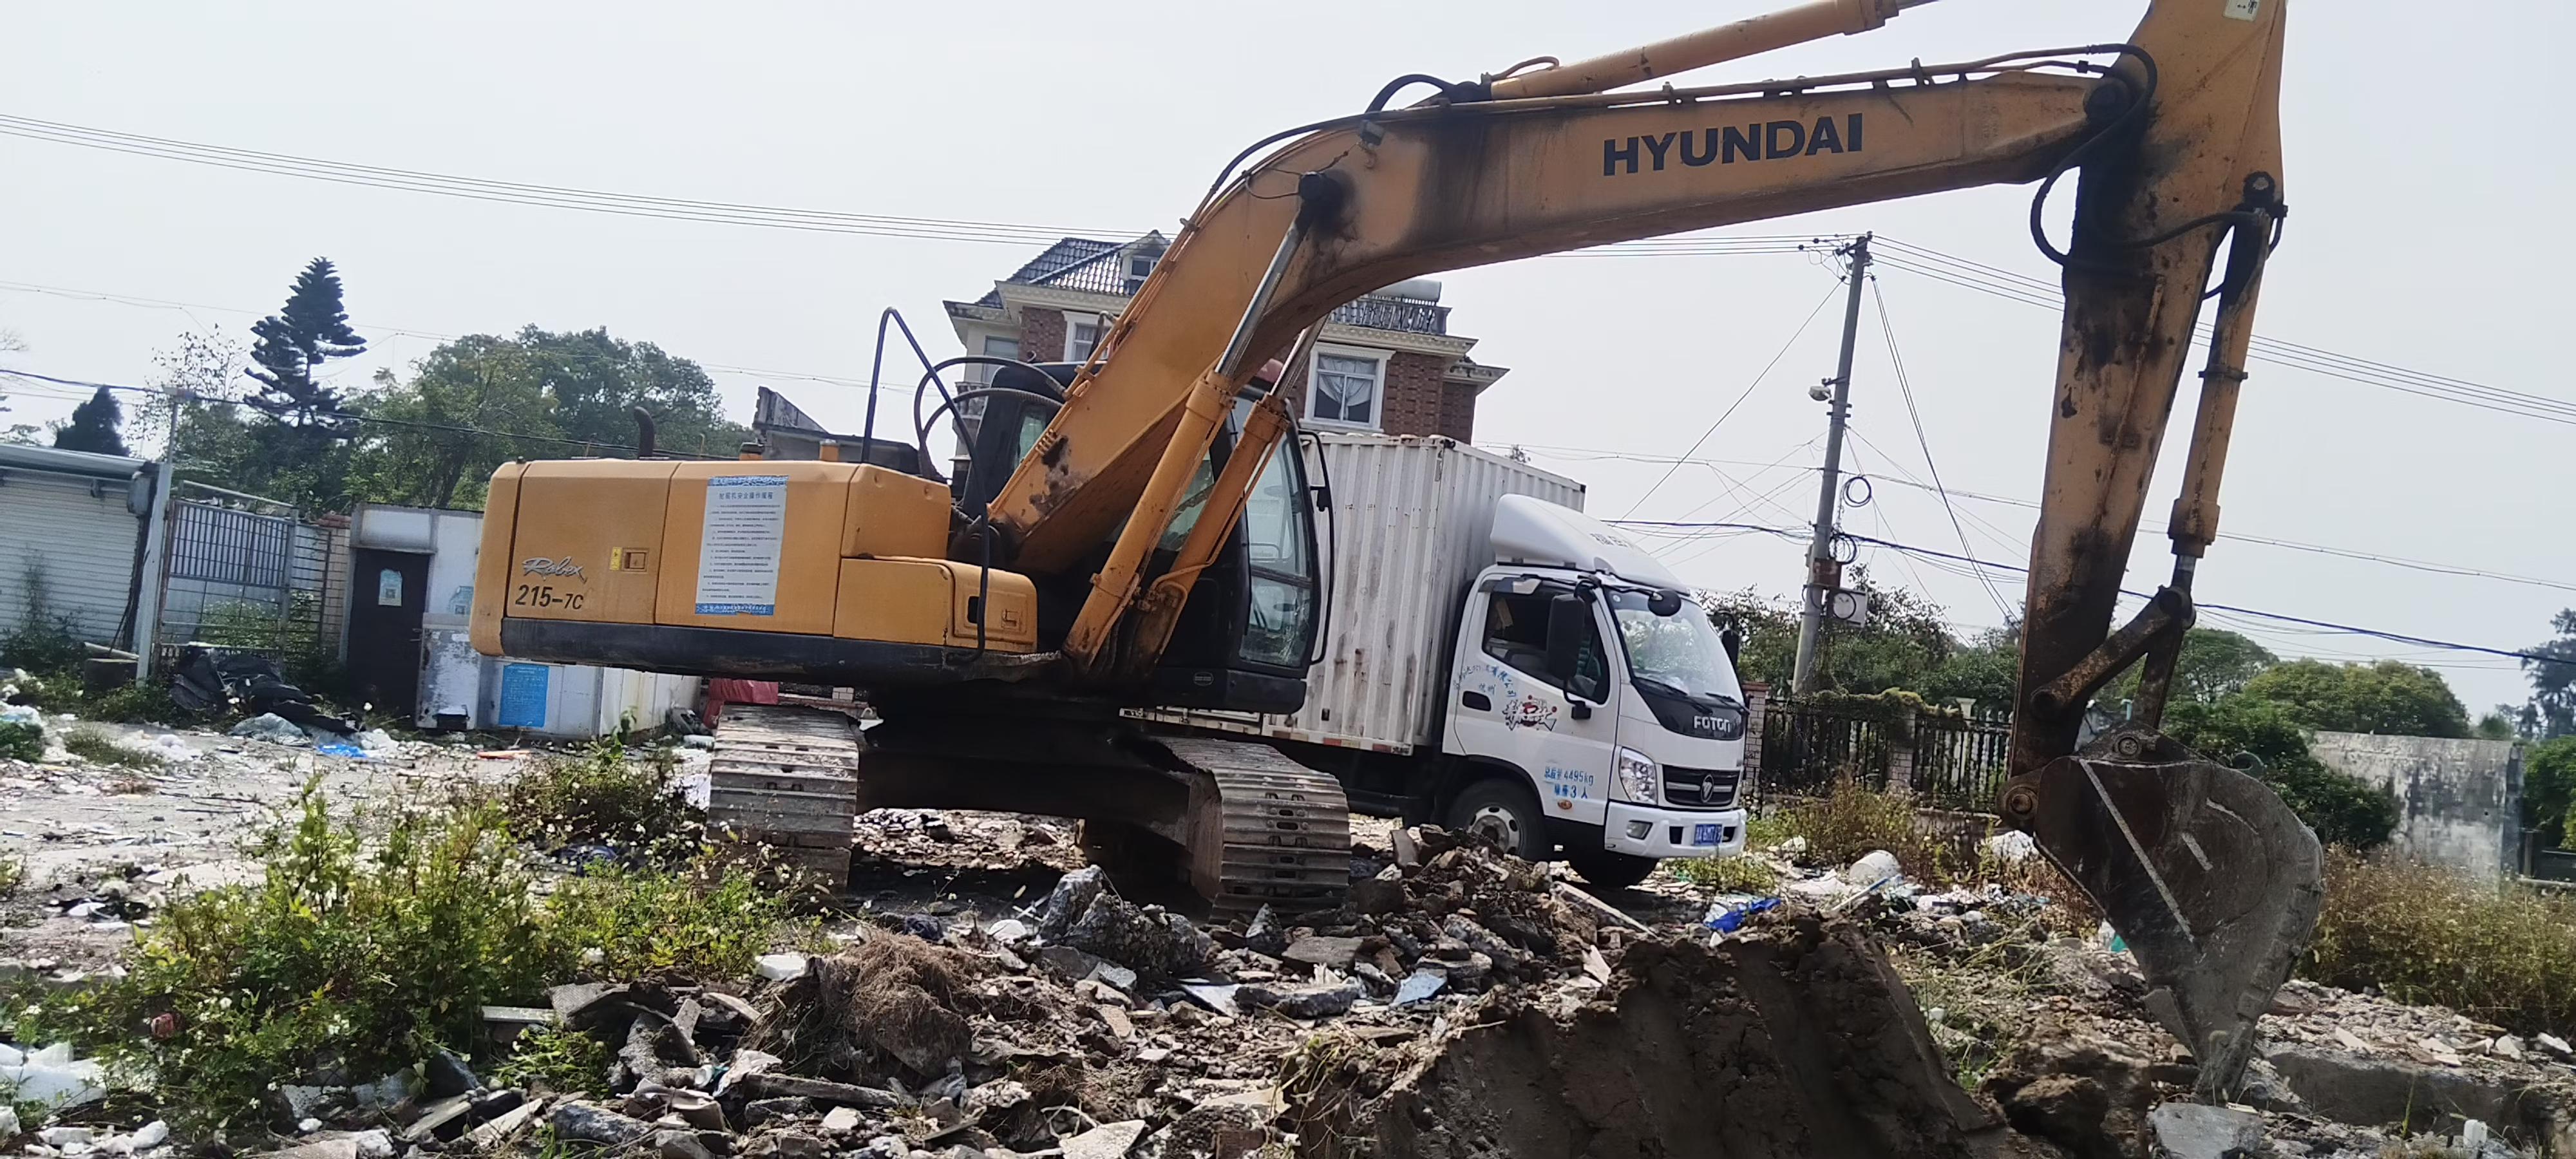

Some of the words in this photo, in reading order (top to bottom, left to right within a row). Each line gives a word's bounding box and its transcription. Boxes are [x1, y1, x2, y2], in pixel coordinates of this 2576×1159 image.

[1603, 113, 1863, 176] HYUNDAI
[522, 556, 587, 584] Robex
[515, 584, 584, 610] 215-7C
[1694, 715, 1730, 733] FOTON
